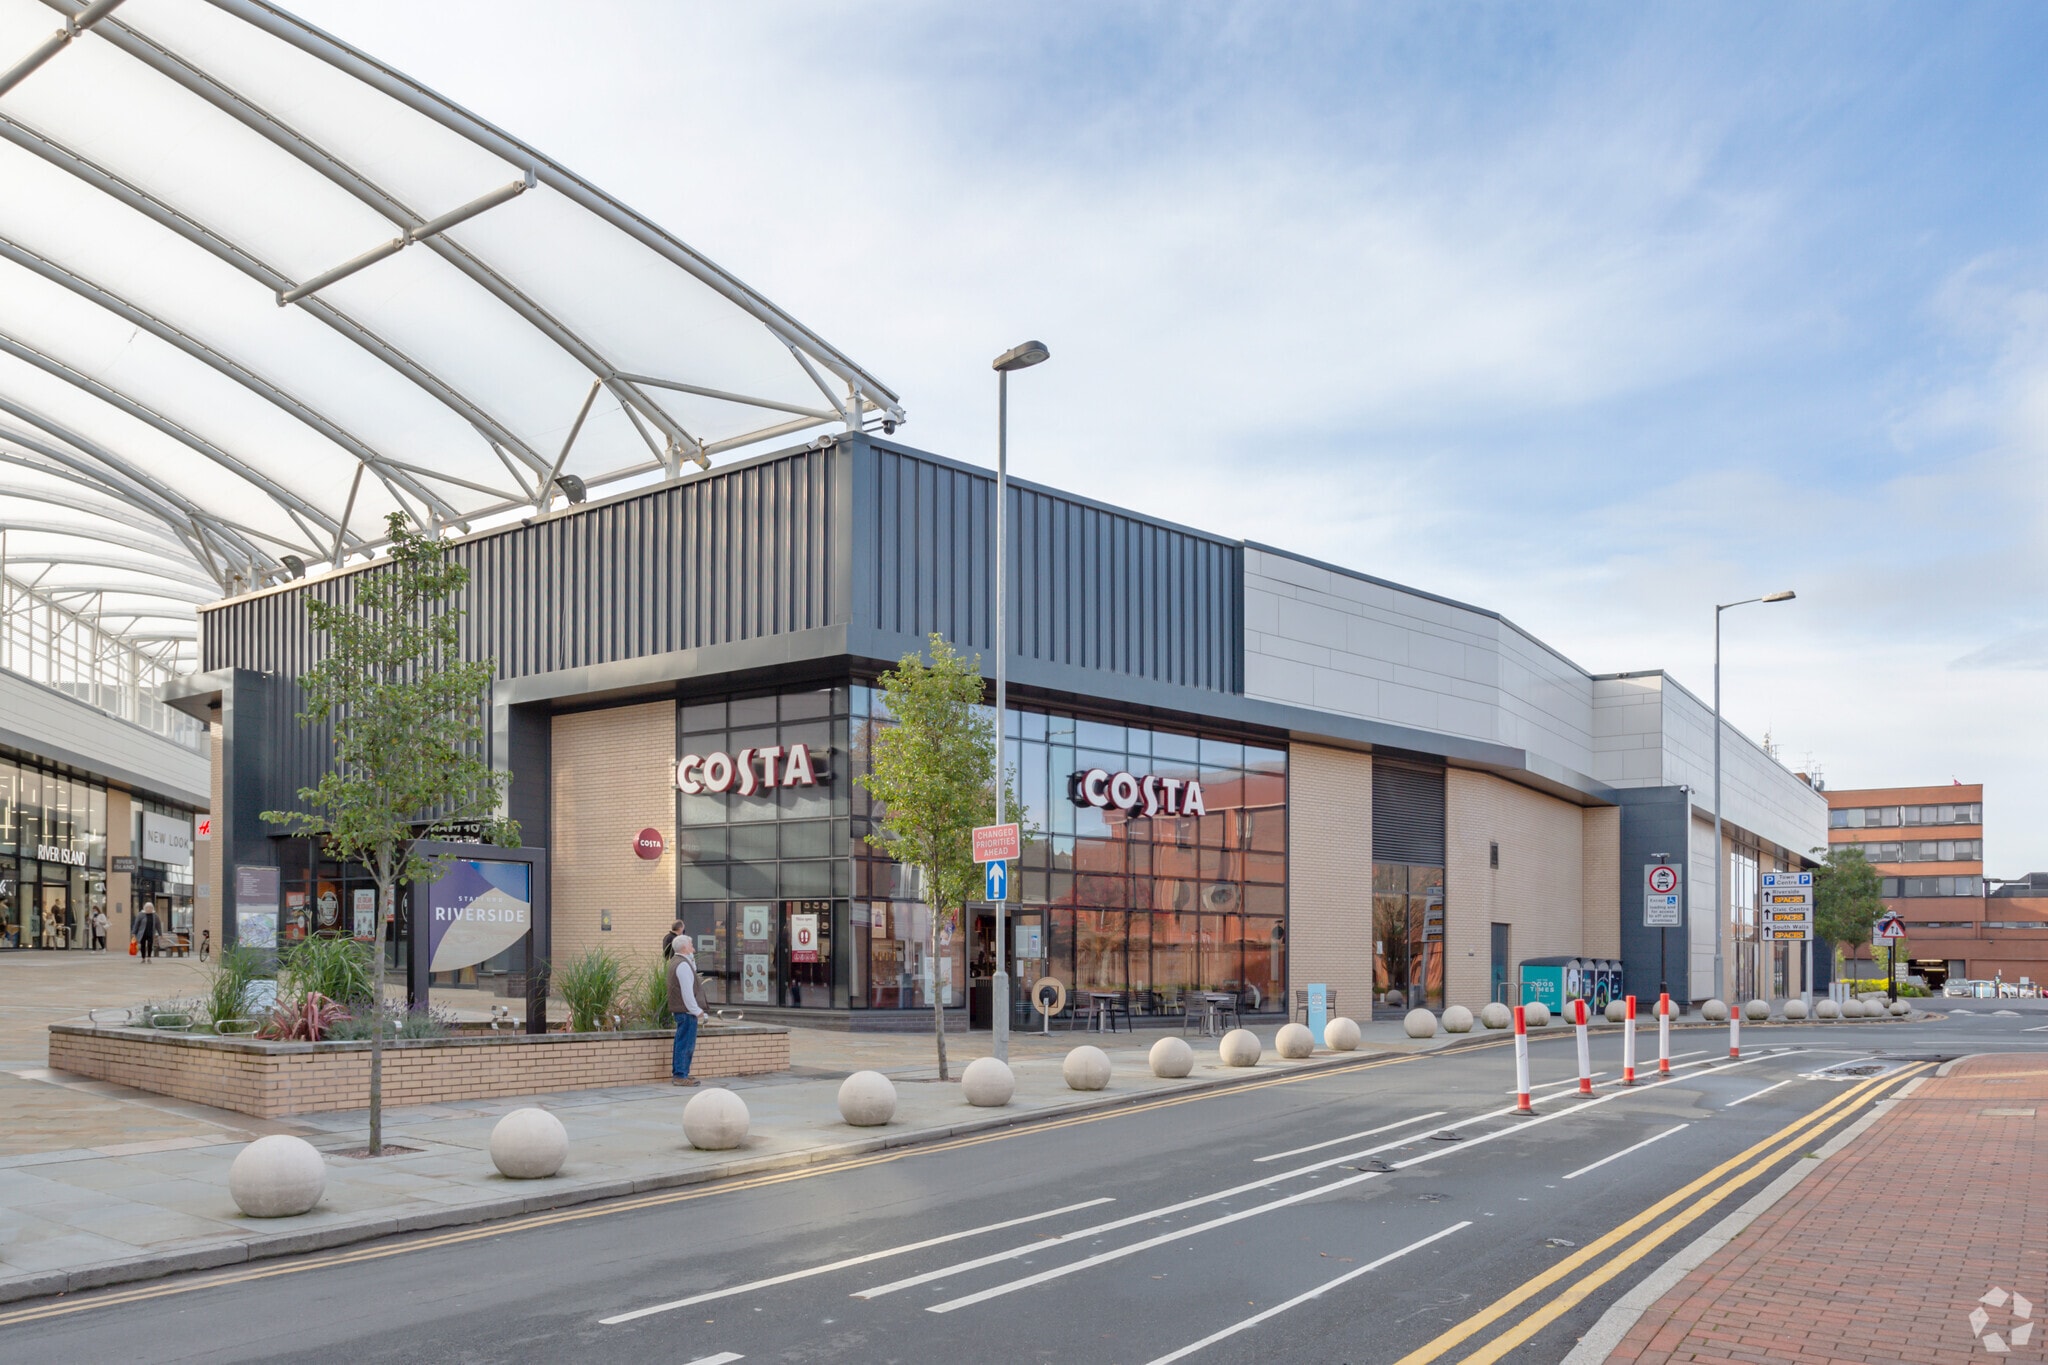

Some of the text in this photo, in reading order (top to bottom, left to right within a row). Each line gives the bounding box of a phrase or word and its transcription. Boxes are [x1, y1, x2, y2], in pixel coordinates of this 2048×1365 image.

[677, 743, 816, 796] COSTA
[1082, 768, 1206, 818] COSTA
[148, 830, 189, 850] NEW LOOK
[977, 828, 1014, 840] CHANGED
[640, 839, 661, 848] COSTA
[976, 837, 1016, 849] PRIORITIES
[38, 844, 86, 866] RIVER ISLAND
[983, 847, 1009, 857] AHEAD
[435, 906, 525, 923] RIVERSIDE
